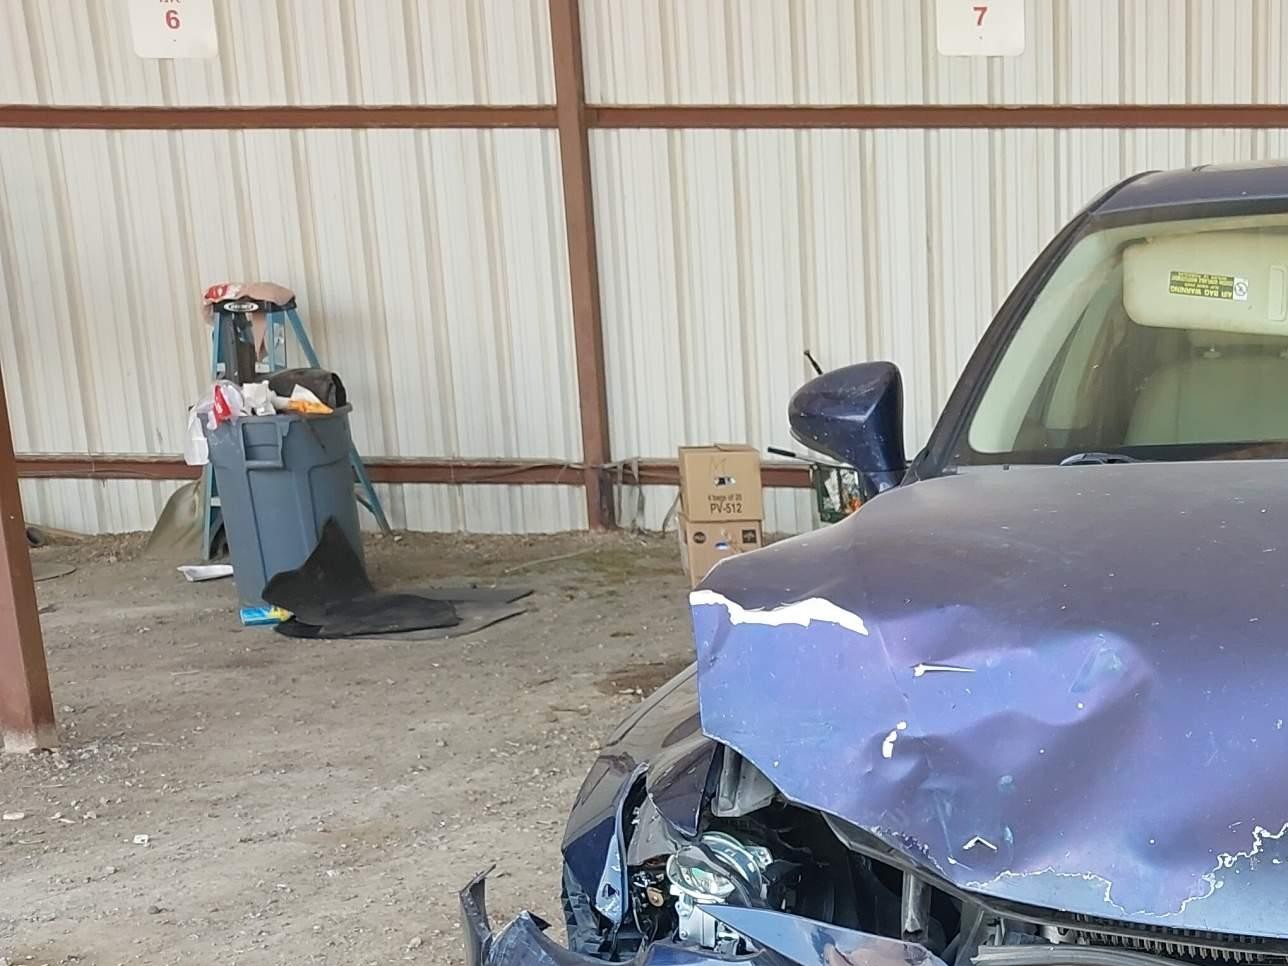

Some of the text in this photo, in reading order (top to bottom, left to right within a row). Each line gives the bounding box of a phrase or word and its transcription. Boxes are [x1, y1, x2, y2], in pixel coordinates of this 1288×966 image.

[165, 9, 180, 29] 6
[973, 6, 988, 26] 7
[710, 502, 743, 514] PV-512
